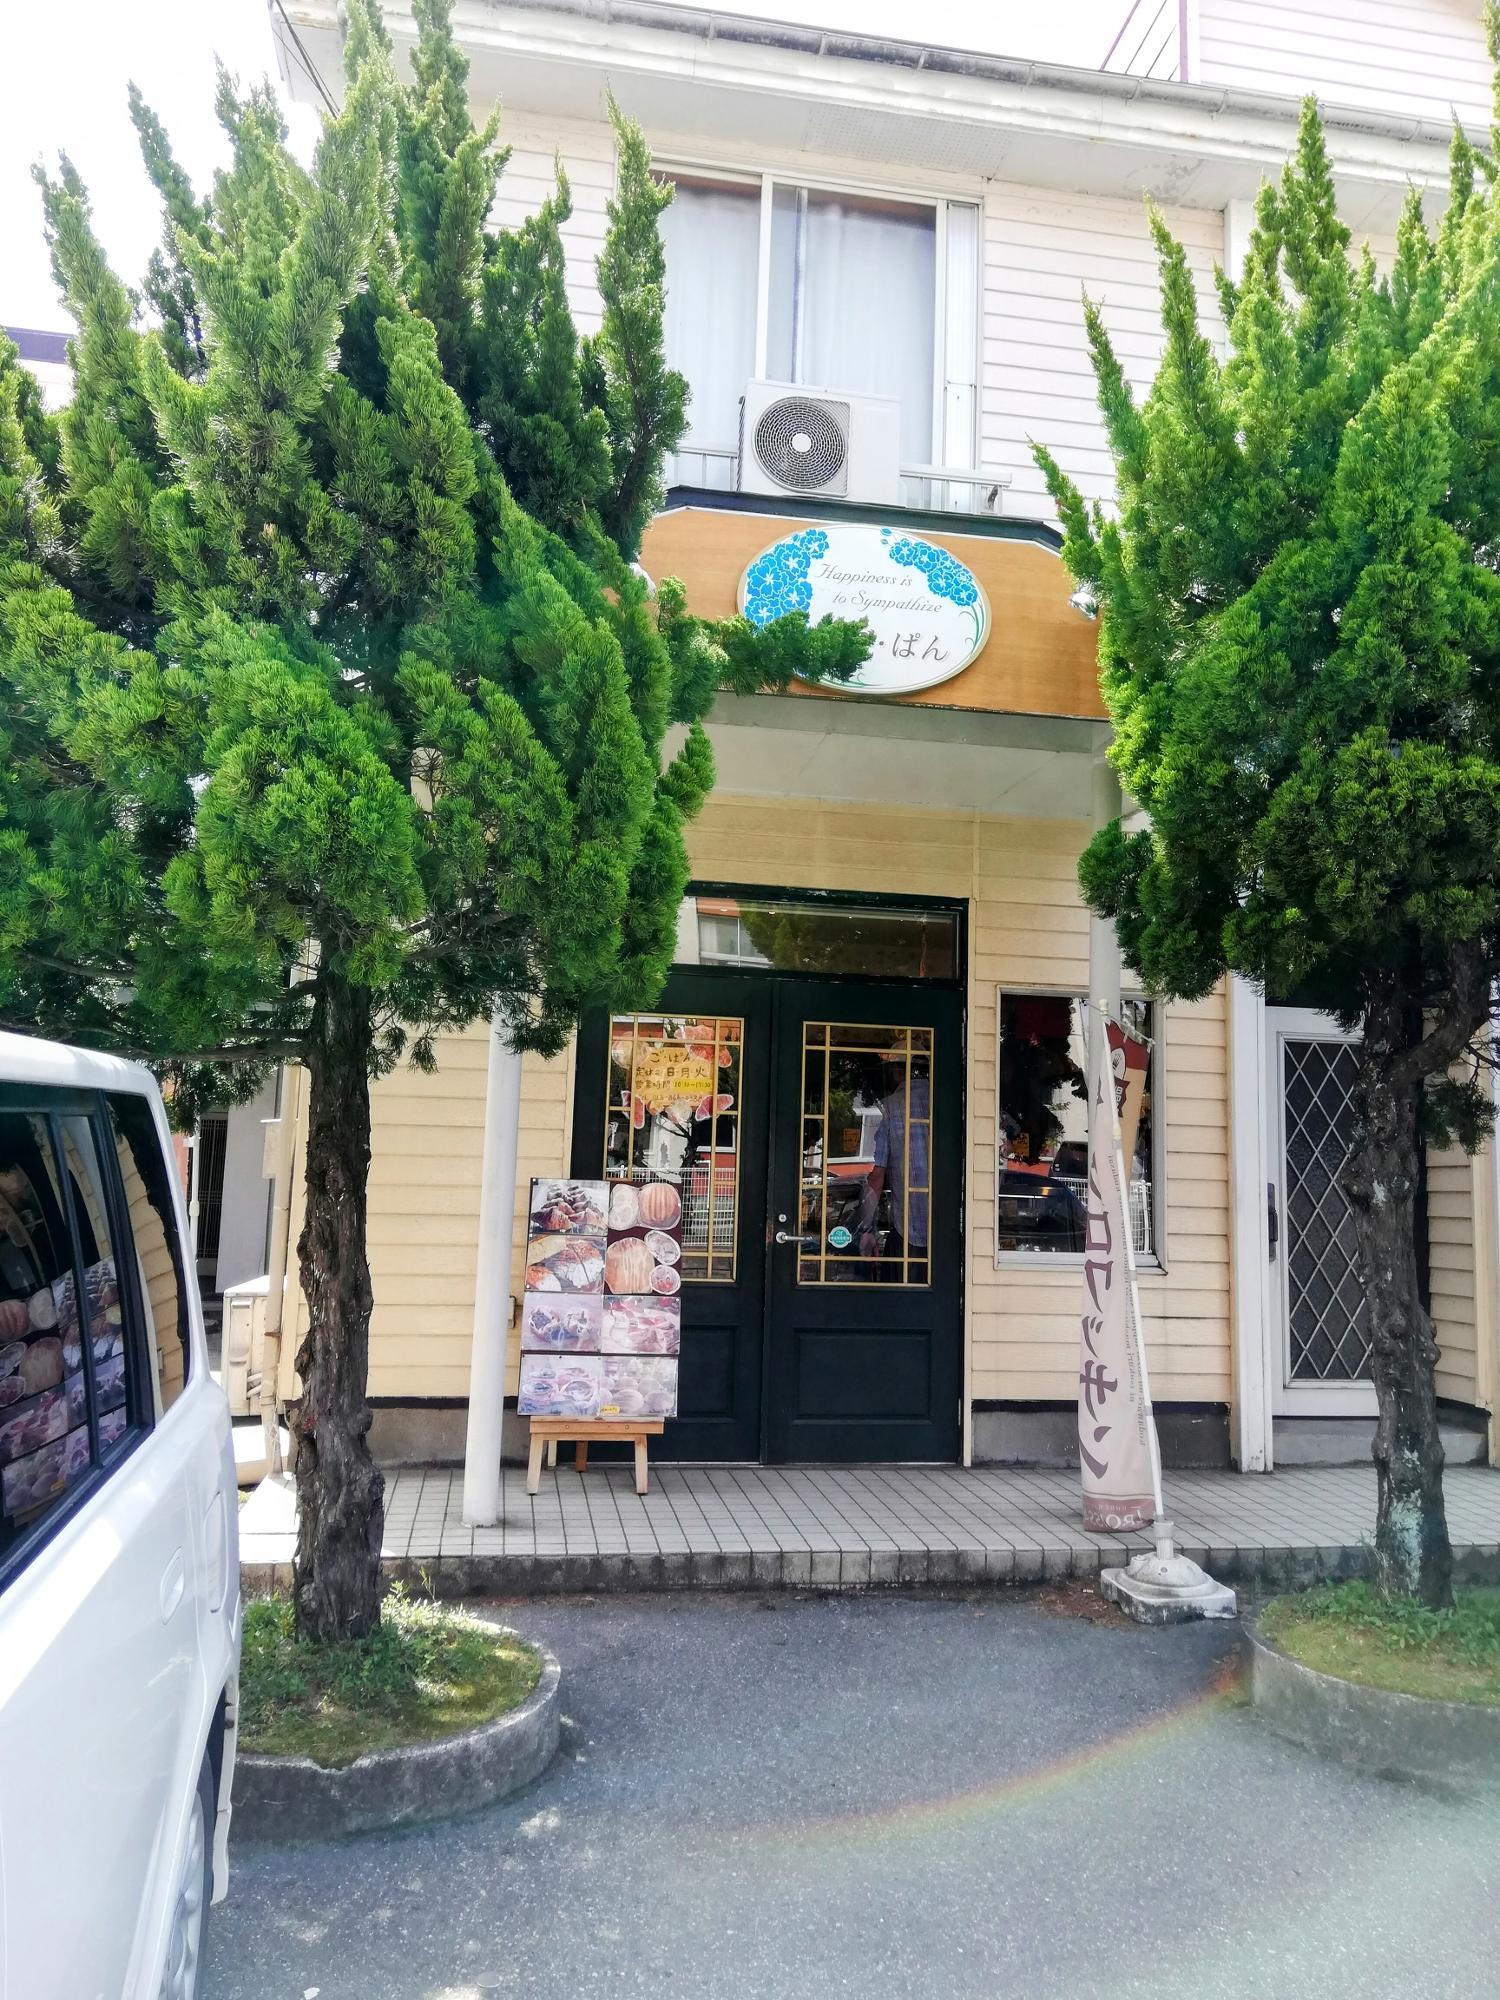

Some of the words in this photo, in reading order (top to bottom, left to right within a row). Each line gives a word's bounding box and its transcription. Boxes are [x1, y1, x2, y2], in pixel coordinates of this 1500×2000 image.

[814, 562, 897, 586] Happiness
[900, 573, 913, 587] is
[833, 592, 847, 604] to
[851, 589, 943, 614] Sympathize
